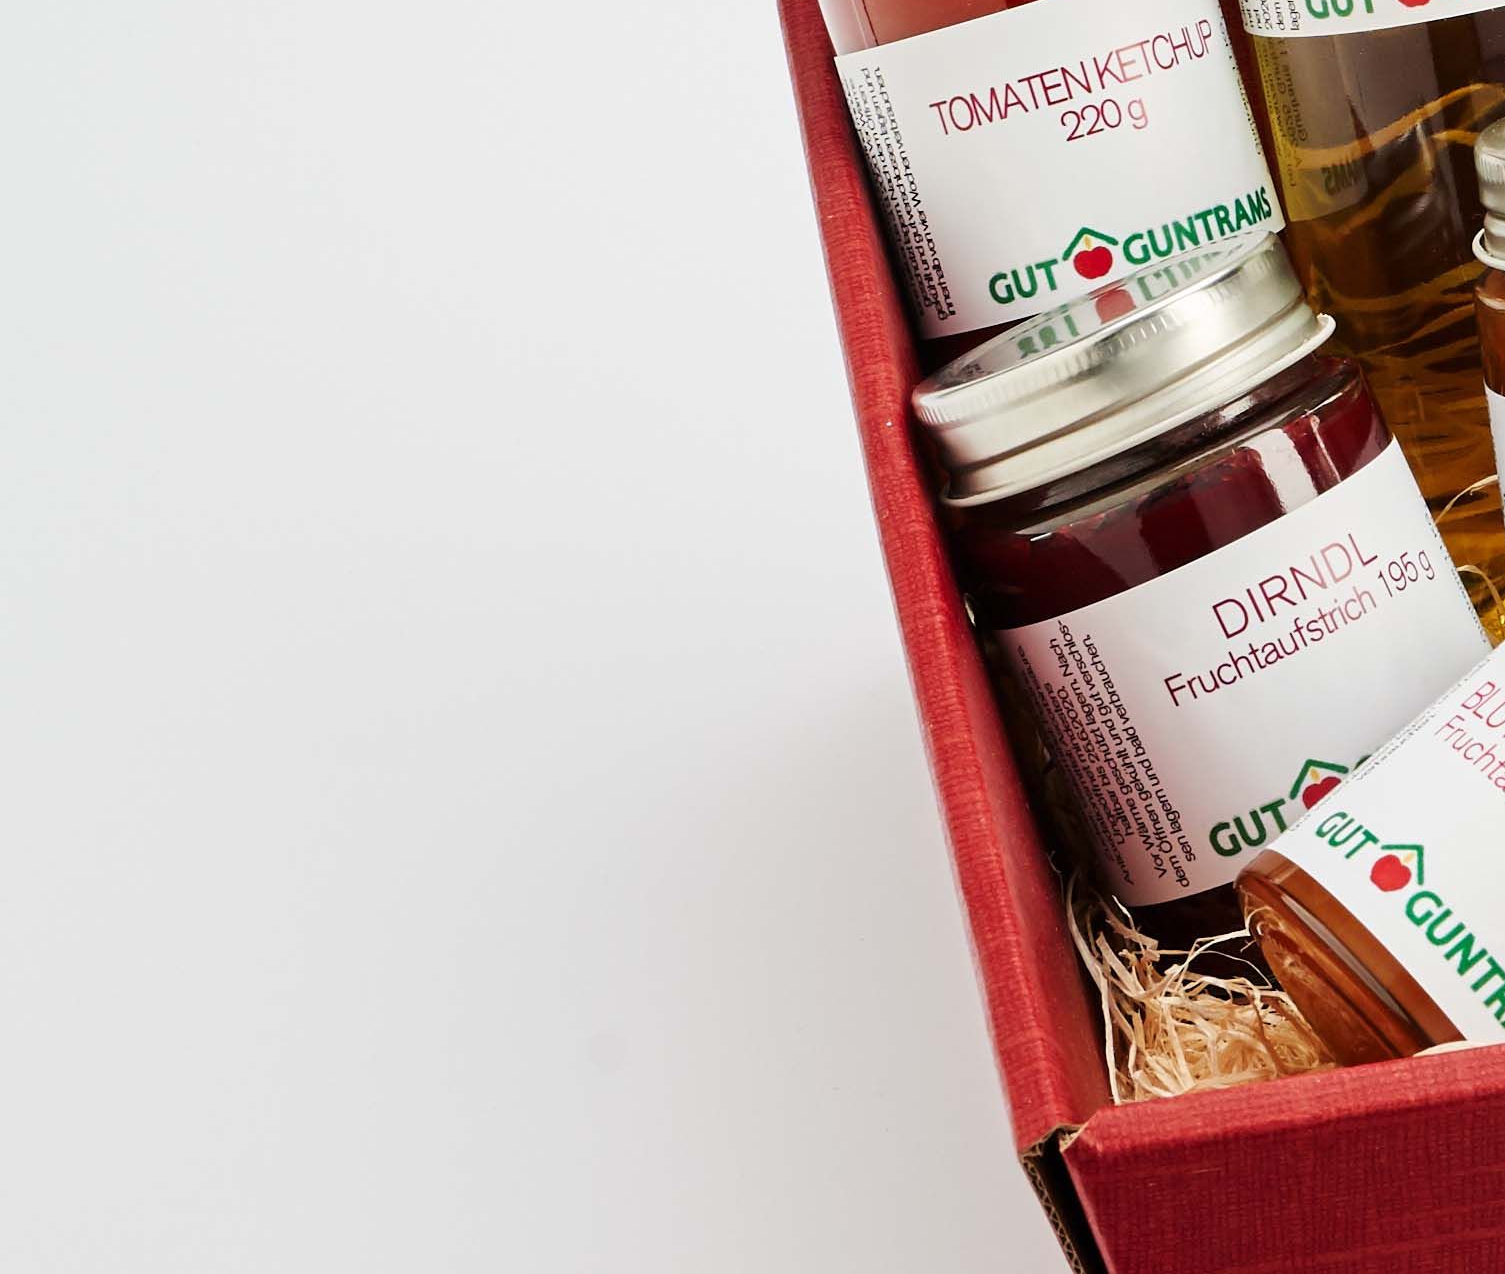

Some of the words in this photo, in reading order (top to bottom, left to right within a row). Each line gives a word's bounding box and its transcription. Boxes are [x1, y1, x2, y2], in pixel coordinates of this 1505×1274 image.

[930, 67, 1092, 136] TOMATEN
[1094, 18, 1213, 86] KETCHUP
[1060, 105, 1124, 142] 220
[1130, 95, 1150, 130] g
[989, 259, 1059, 305] GUT
[1122, 186, 1272, 265] GUNTRAMS
[1212, 533, 1378, 639] DIRNDL
[1164, 585, 1377, 707] Fruchtaufstrich
[1377, 551, 1419, 598] 195
[1418, 549, 1436, 581] g
[1095, 764, 1111, 787] bis
[1105, 788, 1135, 836] haltbar
[1209, 797, 1289, 858] GUT
[1315, 811, 1382, 861] GUT
